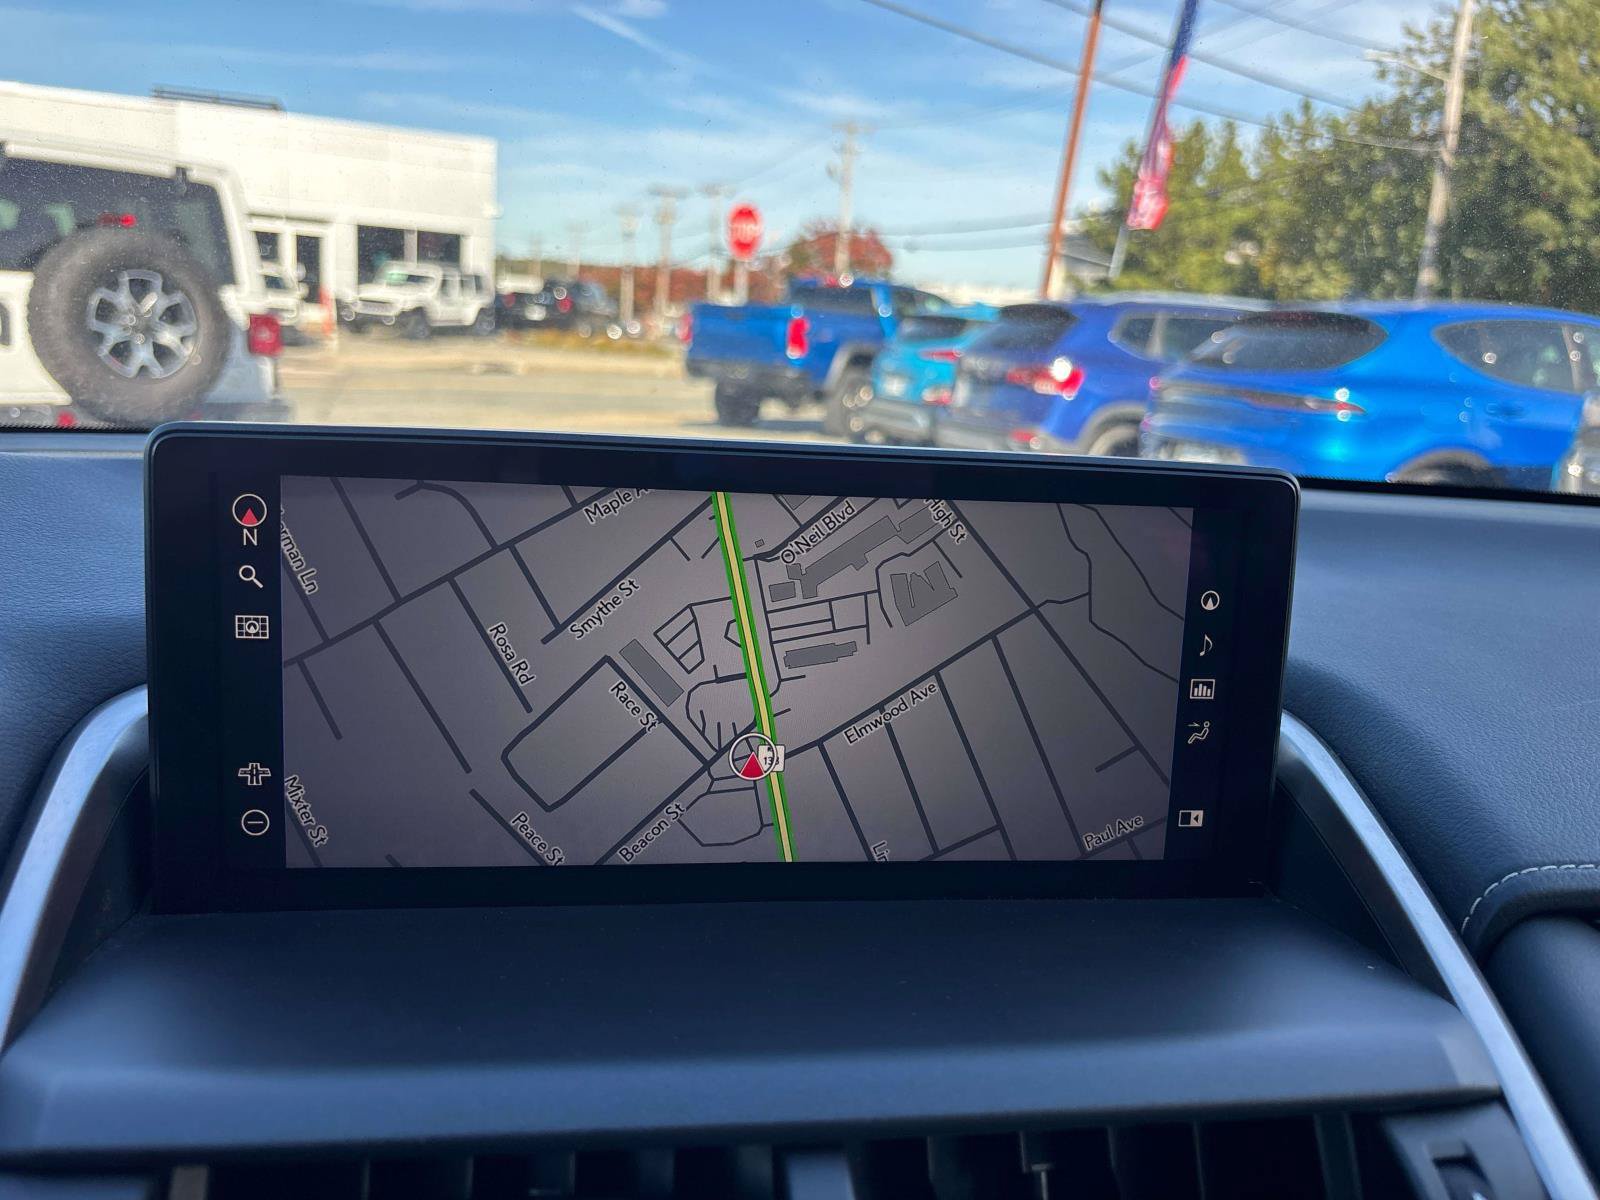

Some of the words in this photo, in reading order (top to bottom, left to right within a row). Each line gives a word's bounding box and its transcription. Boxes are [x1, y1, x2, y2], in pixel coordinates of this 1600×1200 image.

[584, 491, 633, 522] Maple
[781, 525, 825, 563] O'Neil
[822, 502, 855, 532] Blvd
[243, 528, 258, 546] N
[949, 523, 966, 544] St
[300, 570, 318, 593] Ln
[570, 594, 623, 639] Smythe
[619, 579, 639, 598] St
[489, 623, 515, 662] Rosa
[512, 660, 534, 684] Rd
[610, 681, 642, 716] Race
[639, 714, 658, 731] St
[844, 699, 908, 744] Elmwood
[910, 683, 937, 704] Ave
[285, 776, 315, 826] Mixter
[309, 825, 328, 846] St
[619, 819, 669, 862] Beacon
[665, 803, 686, 820] St
[1084, 829, 1114, 850] Paul
[1117, 816, 1144, 836] Ave
[511, 813, 547, 852] Peace
[546, 848, 565, 866] St
